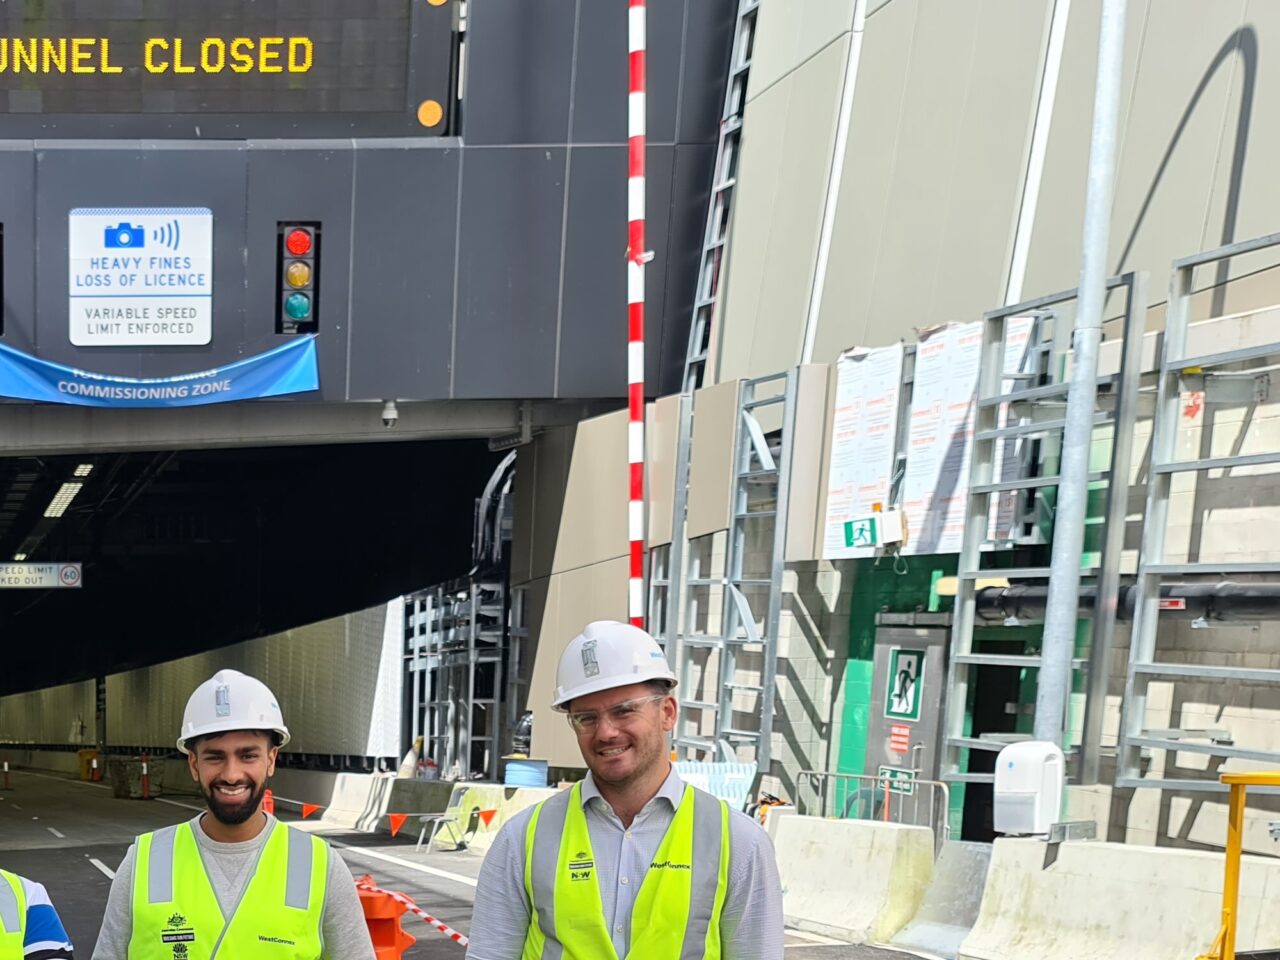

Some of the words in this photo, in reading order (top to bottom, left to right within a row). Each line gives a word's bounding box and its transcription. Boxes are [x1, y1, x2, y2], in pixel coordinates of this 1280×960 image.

[144, 37, 314, 73] CLOSED
[90, 257, 142, 269] HEAVY
[149, 256, 192, 269] FINES
[76, 274, 112, 287] LOSS
[119, 273, 137, 286] OF
[144, 273, 206, 286] LICENCE
[84, 308, 150, 319] VARIABLE
[156, 307, 198, 319] SPEED
[87, 323, 122, 335] LIMIT
[127, 322, 194, 335] ENFORCED
[57, 381, 188, 400] COMMISSIONING
[191, 379, 232, 397] ZONE
[27, 566, 54, 575] LIMIT
[63, 570, 76, 581] 60
[24, 577, 44, 585] OUT
